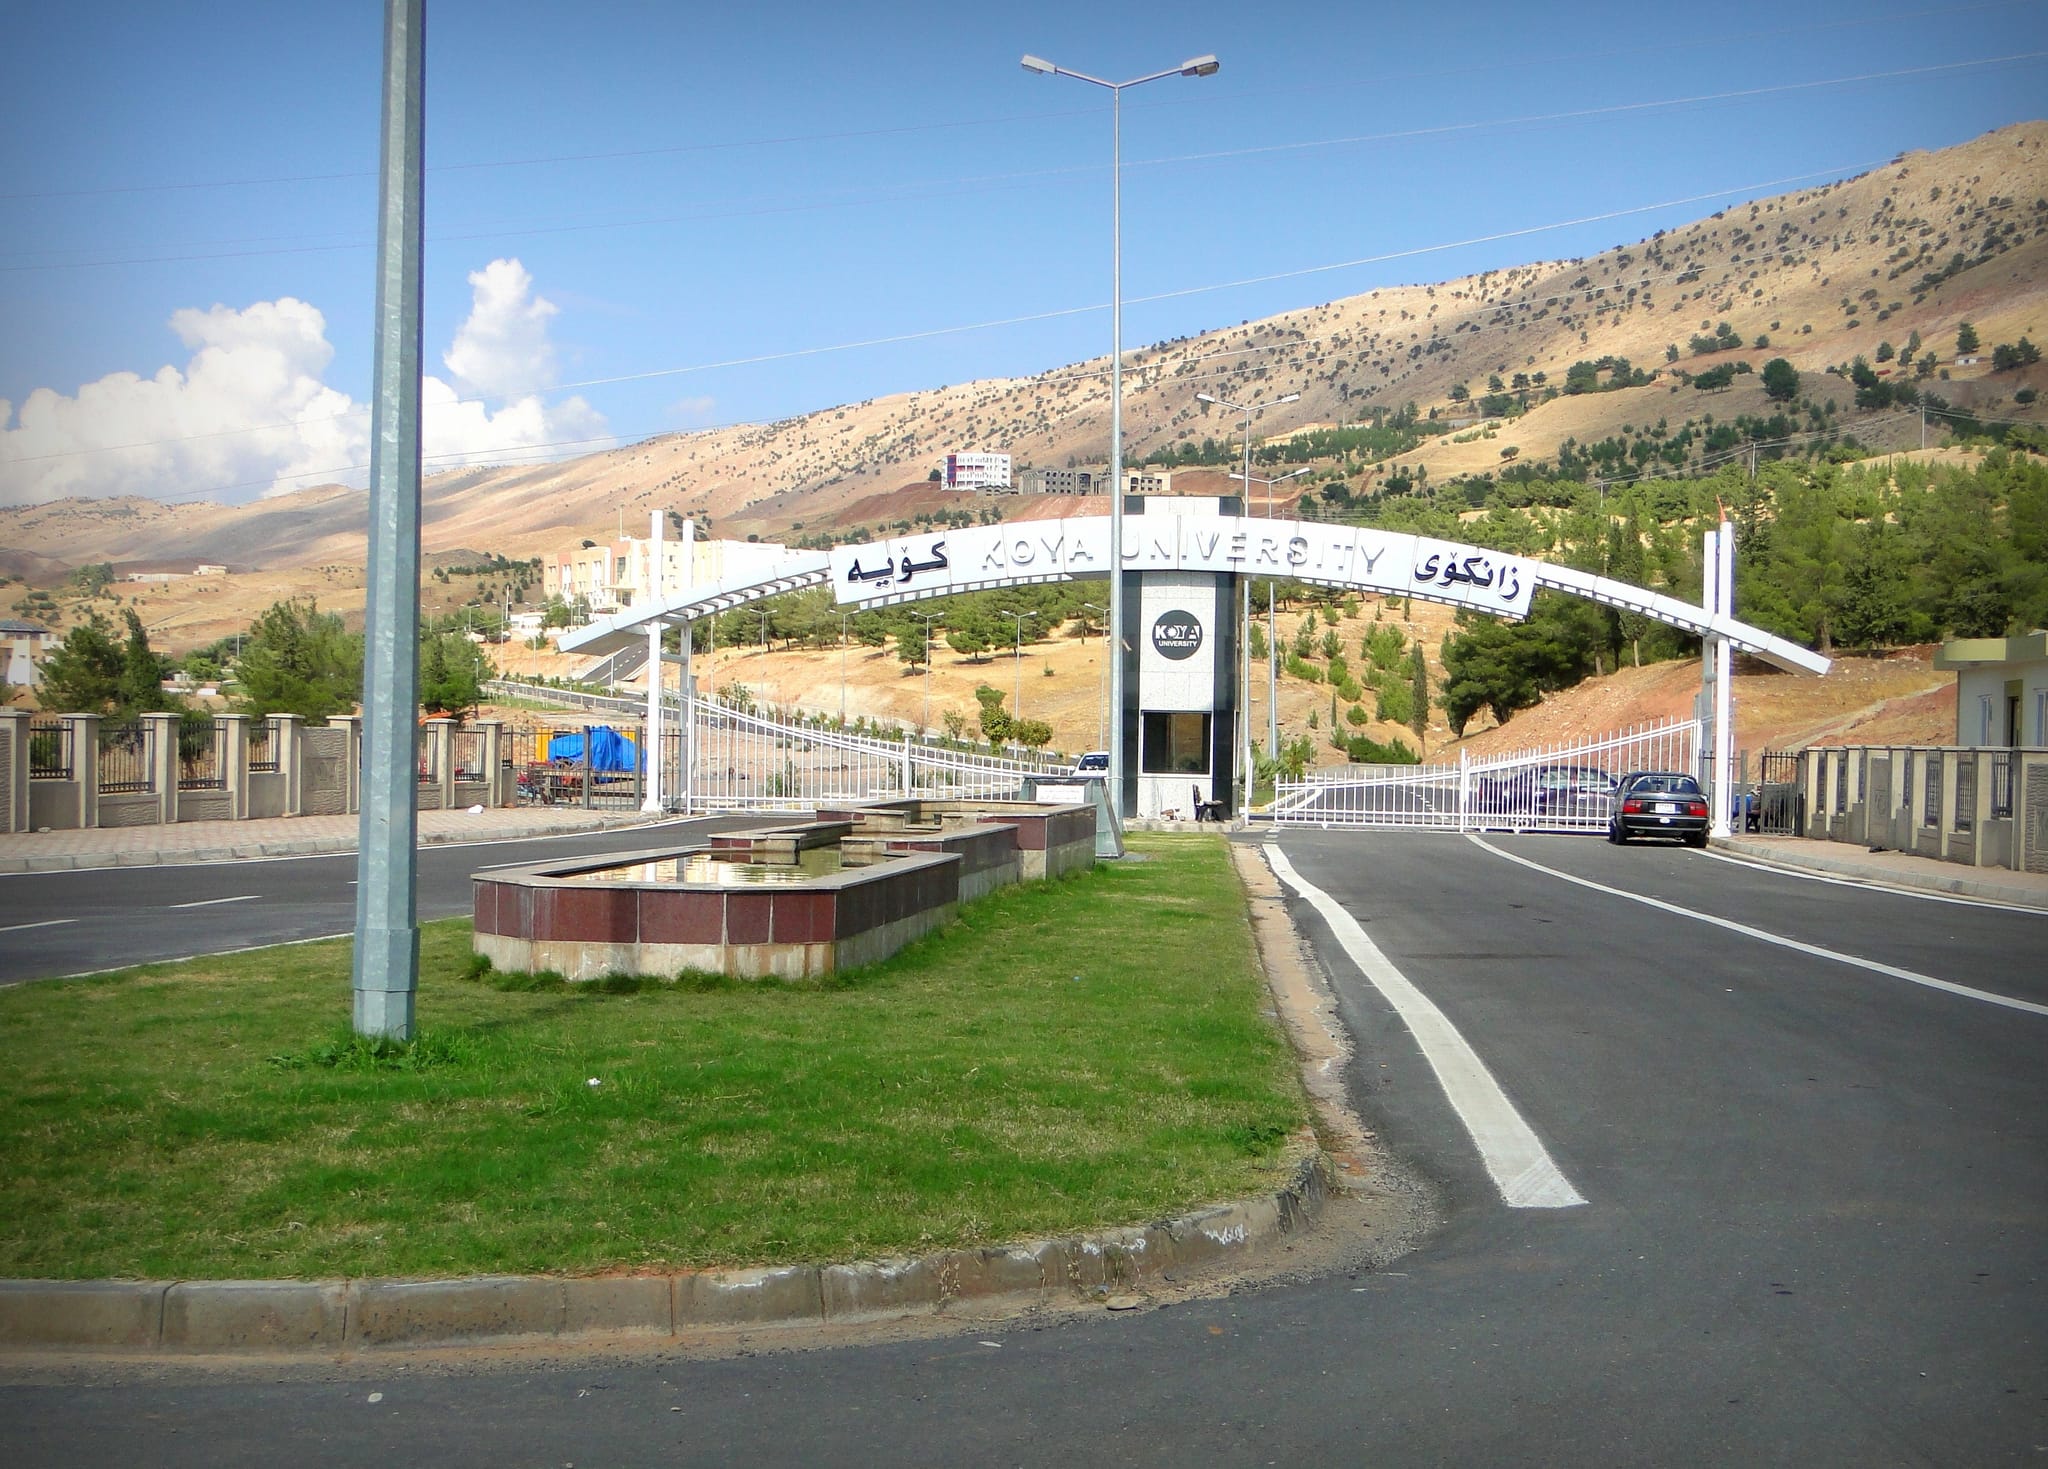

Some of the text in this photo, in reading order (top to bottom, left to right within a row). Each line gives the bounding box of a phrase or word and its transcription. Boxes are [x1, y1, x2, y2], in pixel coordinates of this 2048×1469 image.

[980, 529, 1385, 575] KOYA UNIVERSITY
[1155, 624, 1200, 639] KOYA
[1158, 640, 1198, 648] UNIVERSITY
